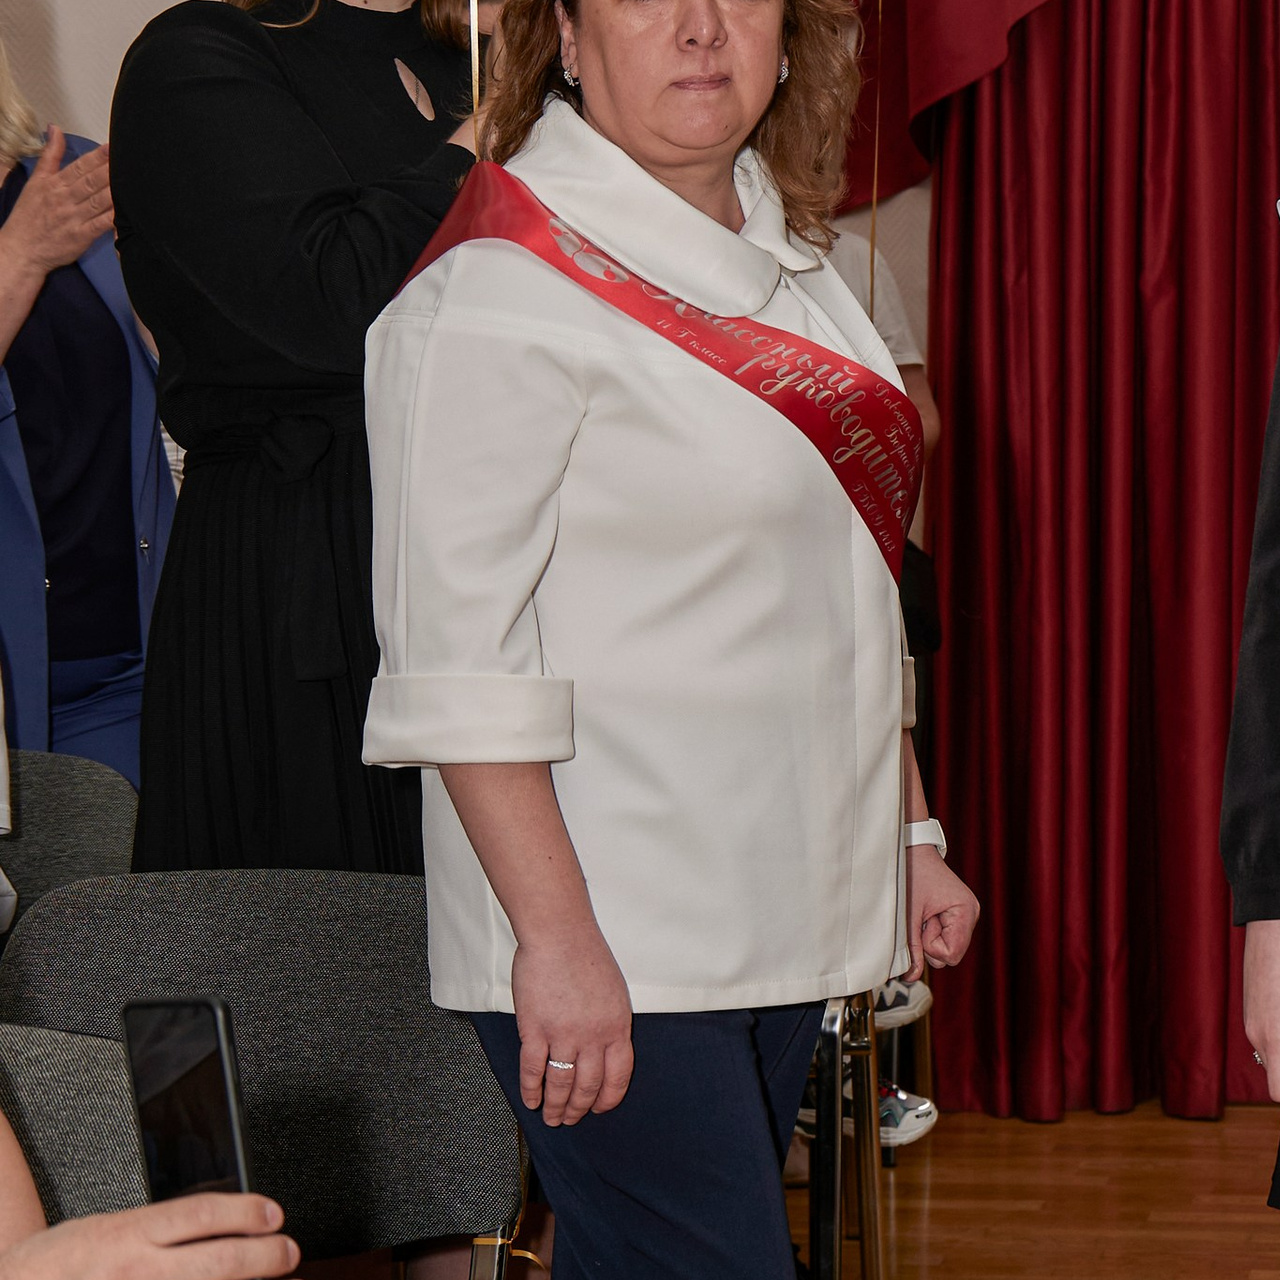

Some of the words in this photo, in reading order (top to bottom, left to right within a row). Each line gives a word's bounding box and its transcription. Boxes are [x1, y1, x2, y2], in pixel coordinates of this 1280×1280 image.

[642, 284, 859, 395] ассный
[688, 340, 728, 364] класс
[734, 353, 909, 538] руководител
